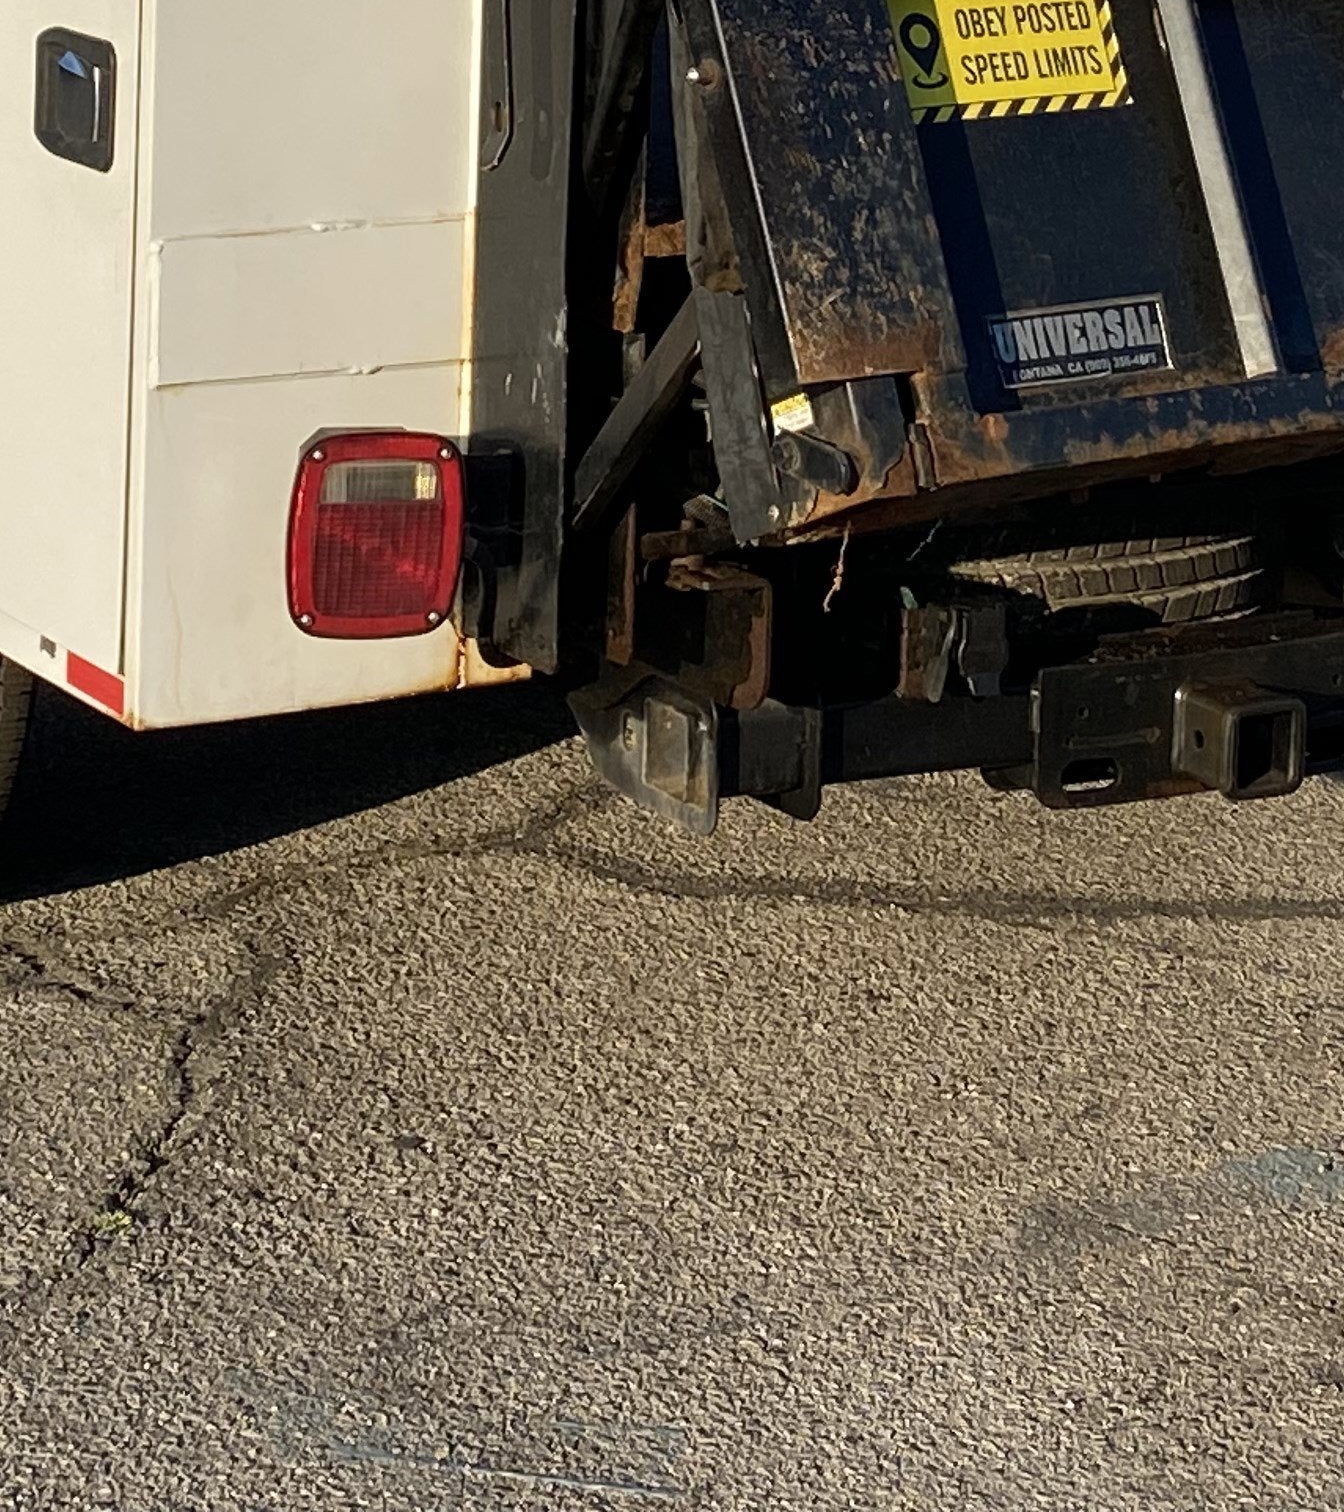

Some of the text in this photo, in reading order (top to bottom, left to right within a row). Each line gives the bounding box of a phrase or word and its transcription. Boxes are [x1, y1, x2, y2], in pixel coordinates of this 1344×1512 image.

[955, 0, 1092, 40] OBEY POSTED
[961, 46, 1104, 86] SPEED LIMITS
[992, 305, 1161, 363] UNIVERSAL
[1068, 361, 1084, 373] CA
